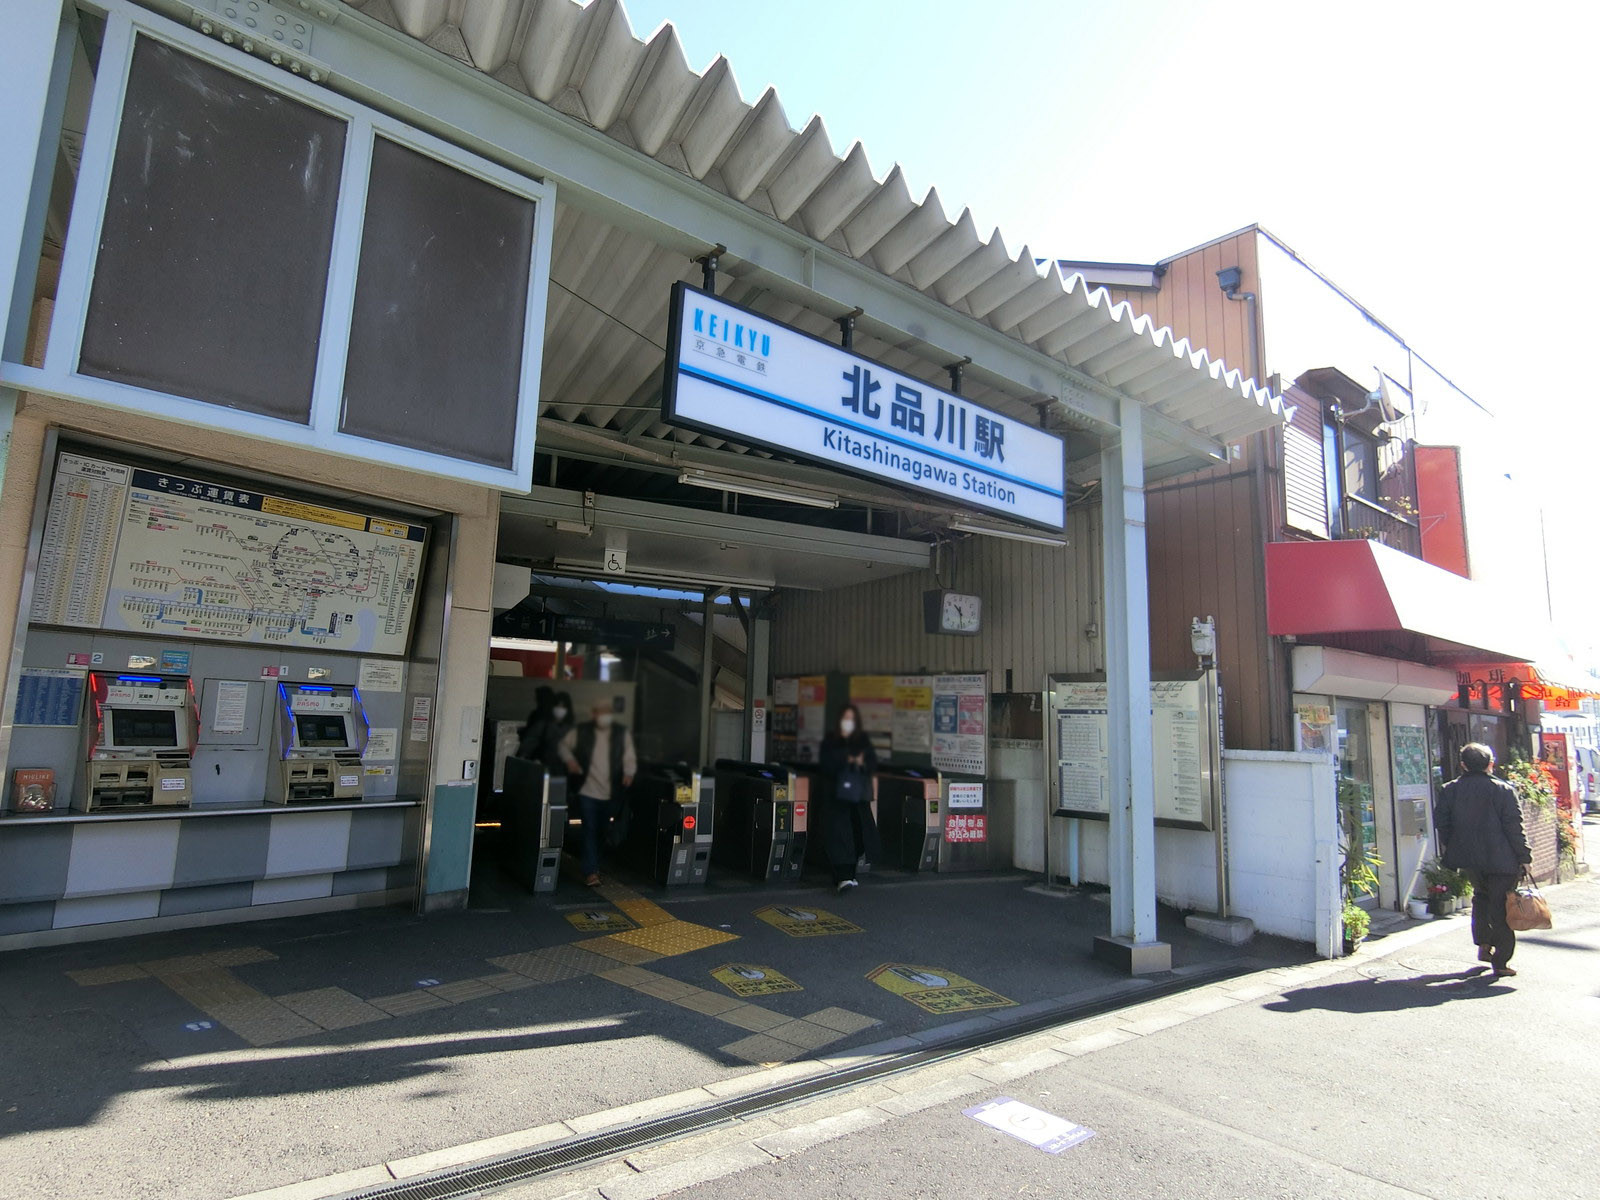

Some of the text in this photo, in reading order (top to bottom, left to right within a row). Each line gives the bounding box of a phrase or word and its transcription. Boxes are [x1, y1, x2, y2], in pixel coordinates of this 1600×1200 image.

[693, 307, 772, 358] KEIKYU
[693, 338, 768, 375] 京急電鉄
[840, 364, 1006, 464] 北品川駅
[823, 425, 1016, 505] Kitashinagawa Station
[157, 477, 251, 505] きっぷ運賃表
[93, 653, 102, 662] 2
